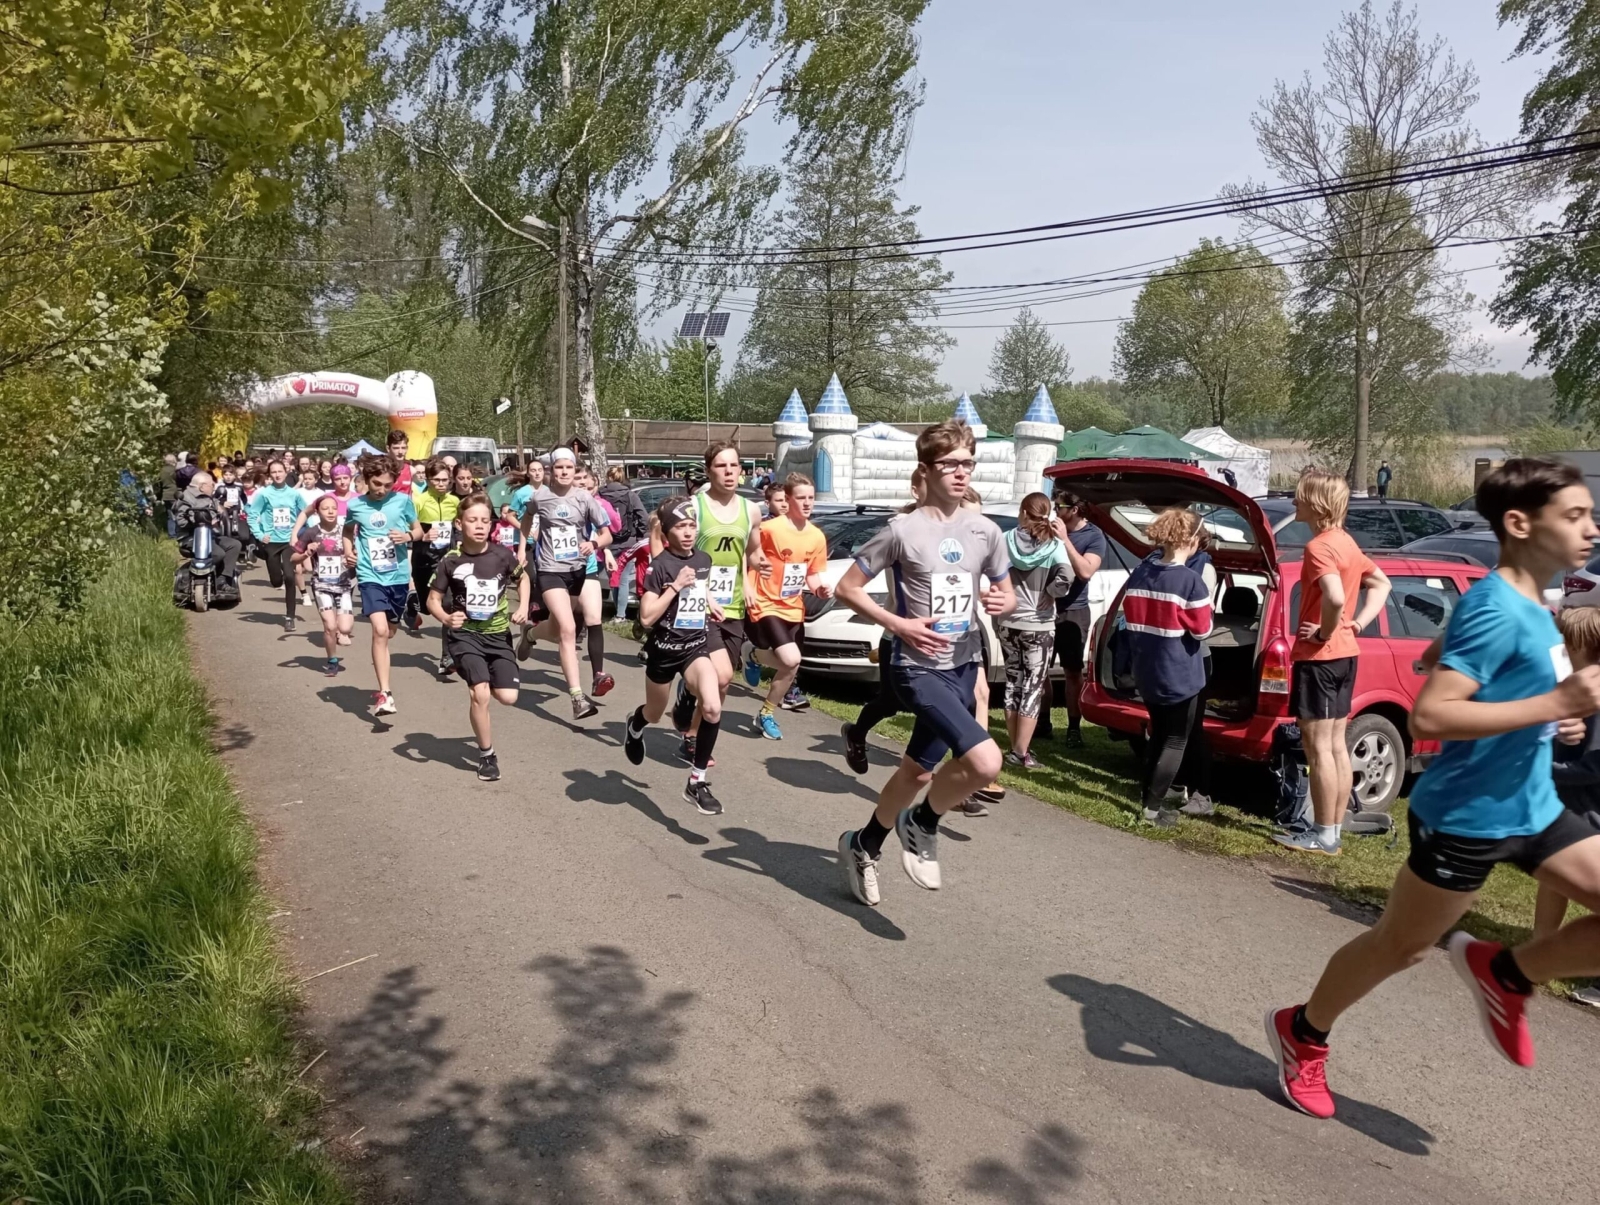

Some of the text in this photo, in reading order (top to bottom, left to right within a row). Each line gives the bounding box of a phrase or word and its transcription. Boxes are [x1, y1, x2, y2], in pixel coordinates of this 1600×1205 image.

[311, 379, 356, 394] PRIMATOR
[274, 515, 290, 523] 215
[553, 536, 577, 549] 216
[371, 548, 396, 561] 233
[319, 565, 339, 574] 211
[709, 579, 733, 592] 241
[783, 575, 805, 587] 232
[467, 593, 497, 607] 229
[679, 597, 706, 612] 228
[933, 594, 971, 614] 217
[654, 635, 707, 650] NIKE PRO
